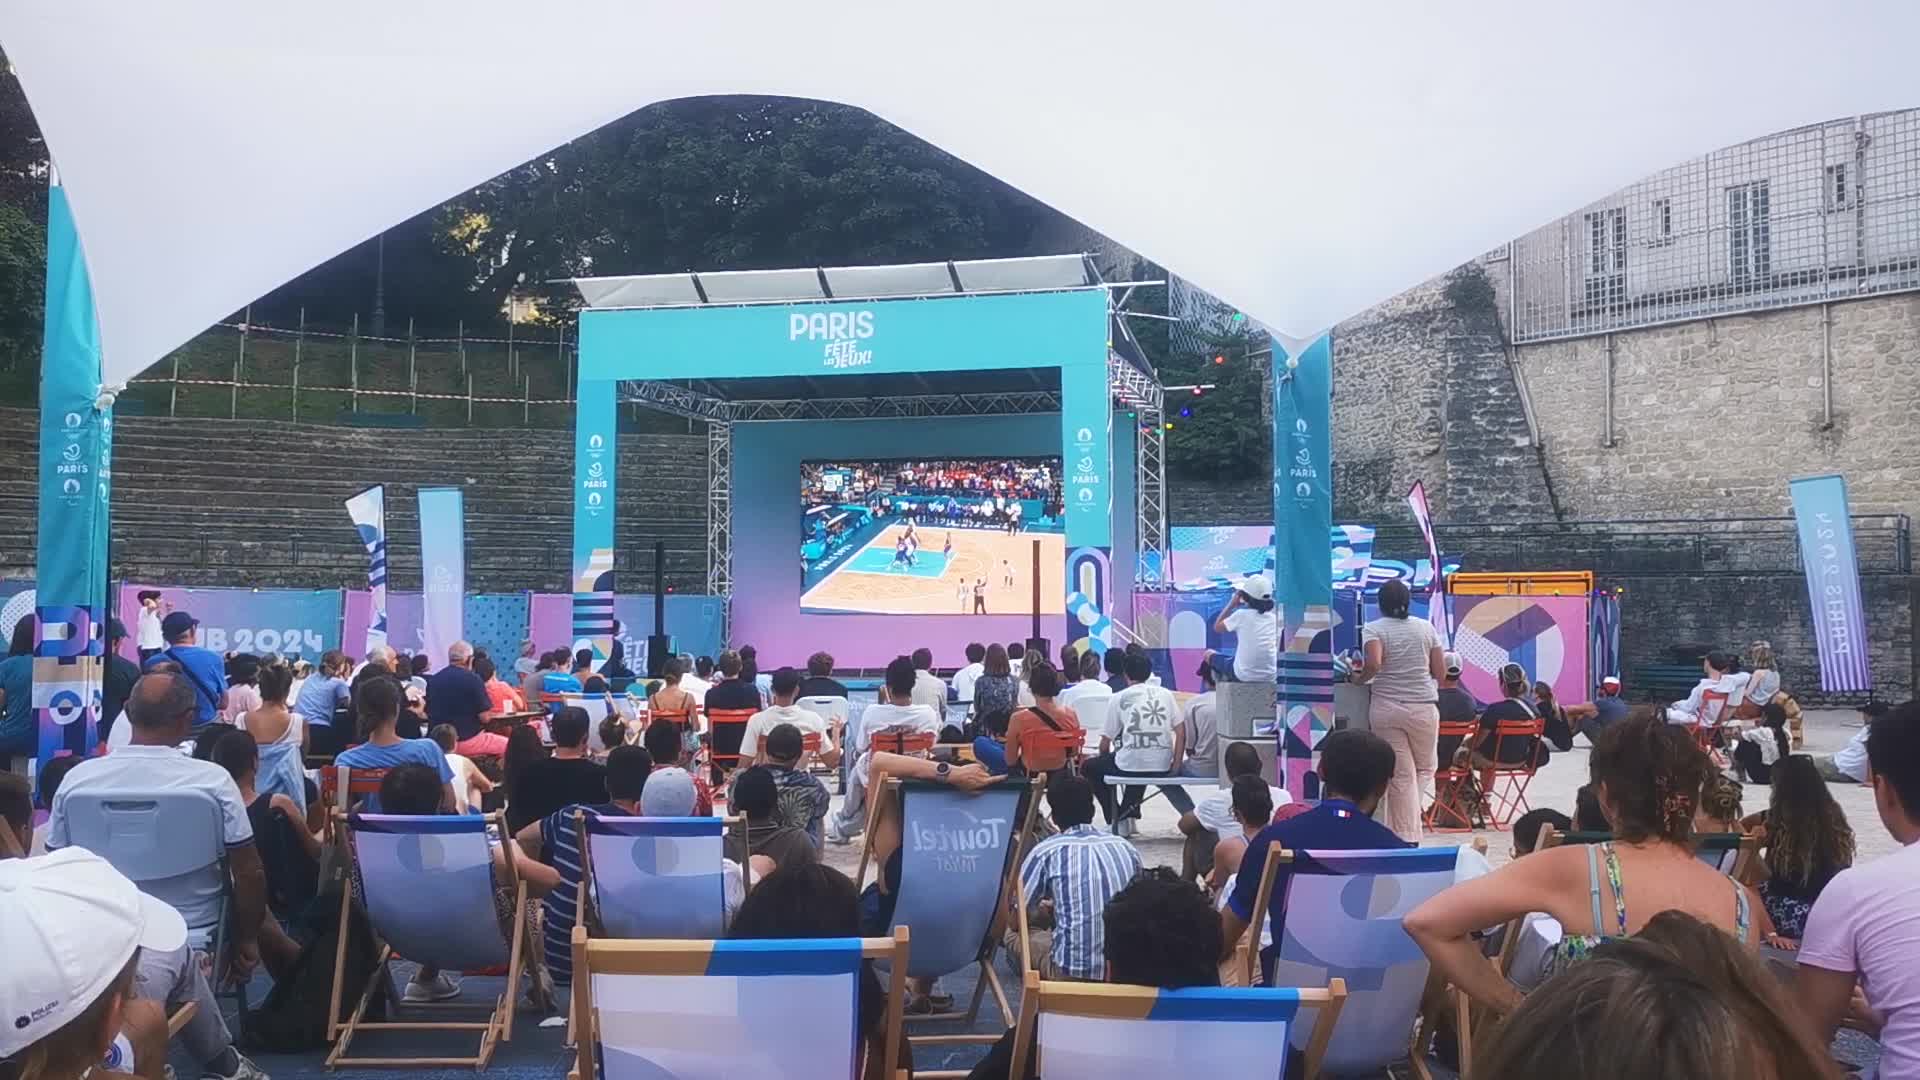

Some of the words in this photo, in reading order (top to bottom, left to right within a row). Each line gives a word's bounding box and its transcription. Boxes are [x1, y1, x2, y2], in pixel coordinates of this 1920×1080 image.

[790, 311, 874, 340] PARIS
[824, 339, 857, 357] FÊTE
[57, 464, 88, 474] PARIS
[1290, 468, 1317, 478] PARIS
[583, 480, 608, 489] PARIS
[1072, 475, 1099, 484] PARIS
[234, 628, 322, 653] 2024
